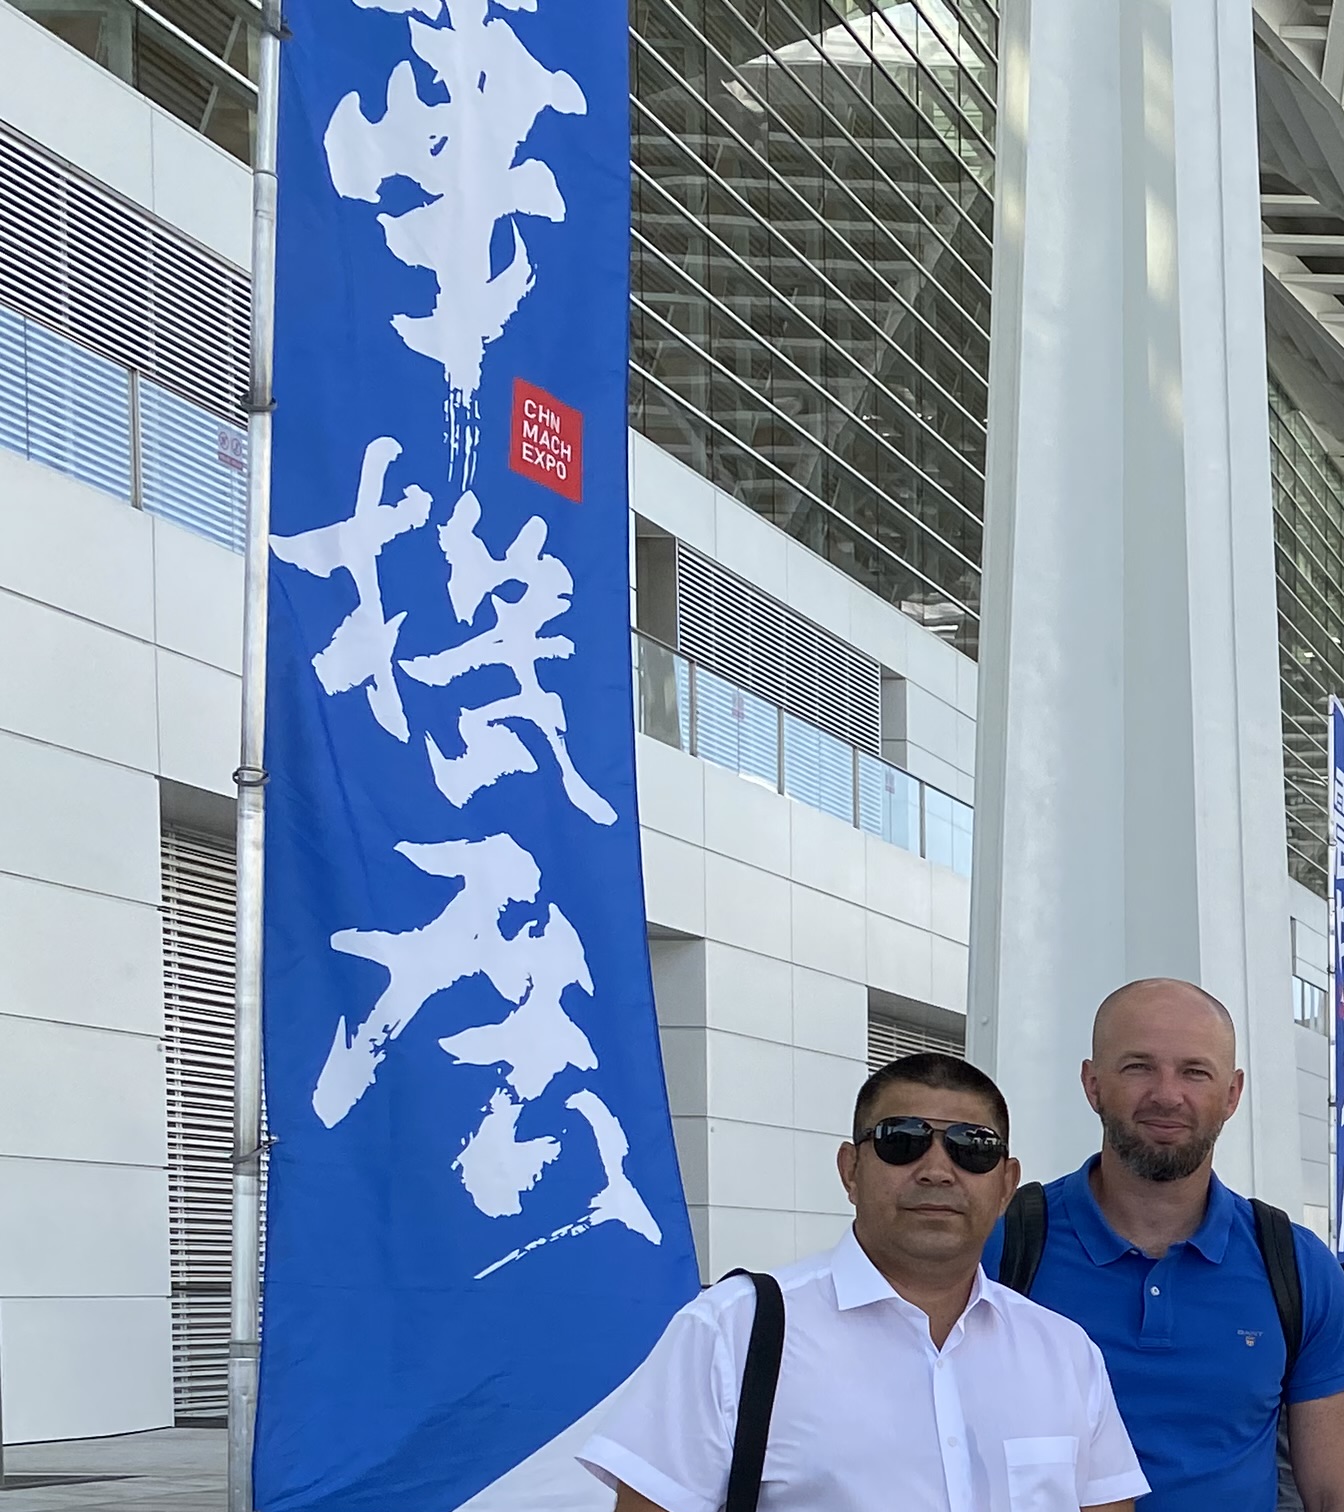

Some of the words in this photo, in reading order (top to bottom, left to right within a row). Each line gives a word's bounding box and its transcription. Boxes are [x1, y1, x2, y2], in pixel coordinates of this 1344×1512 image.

[524, 399, 560, 434] CHN
[522, 441, 567, 481] EXPO
[523, 420, 571, 463] MACH
